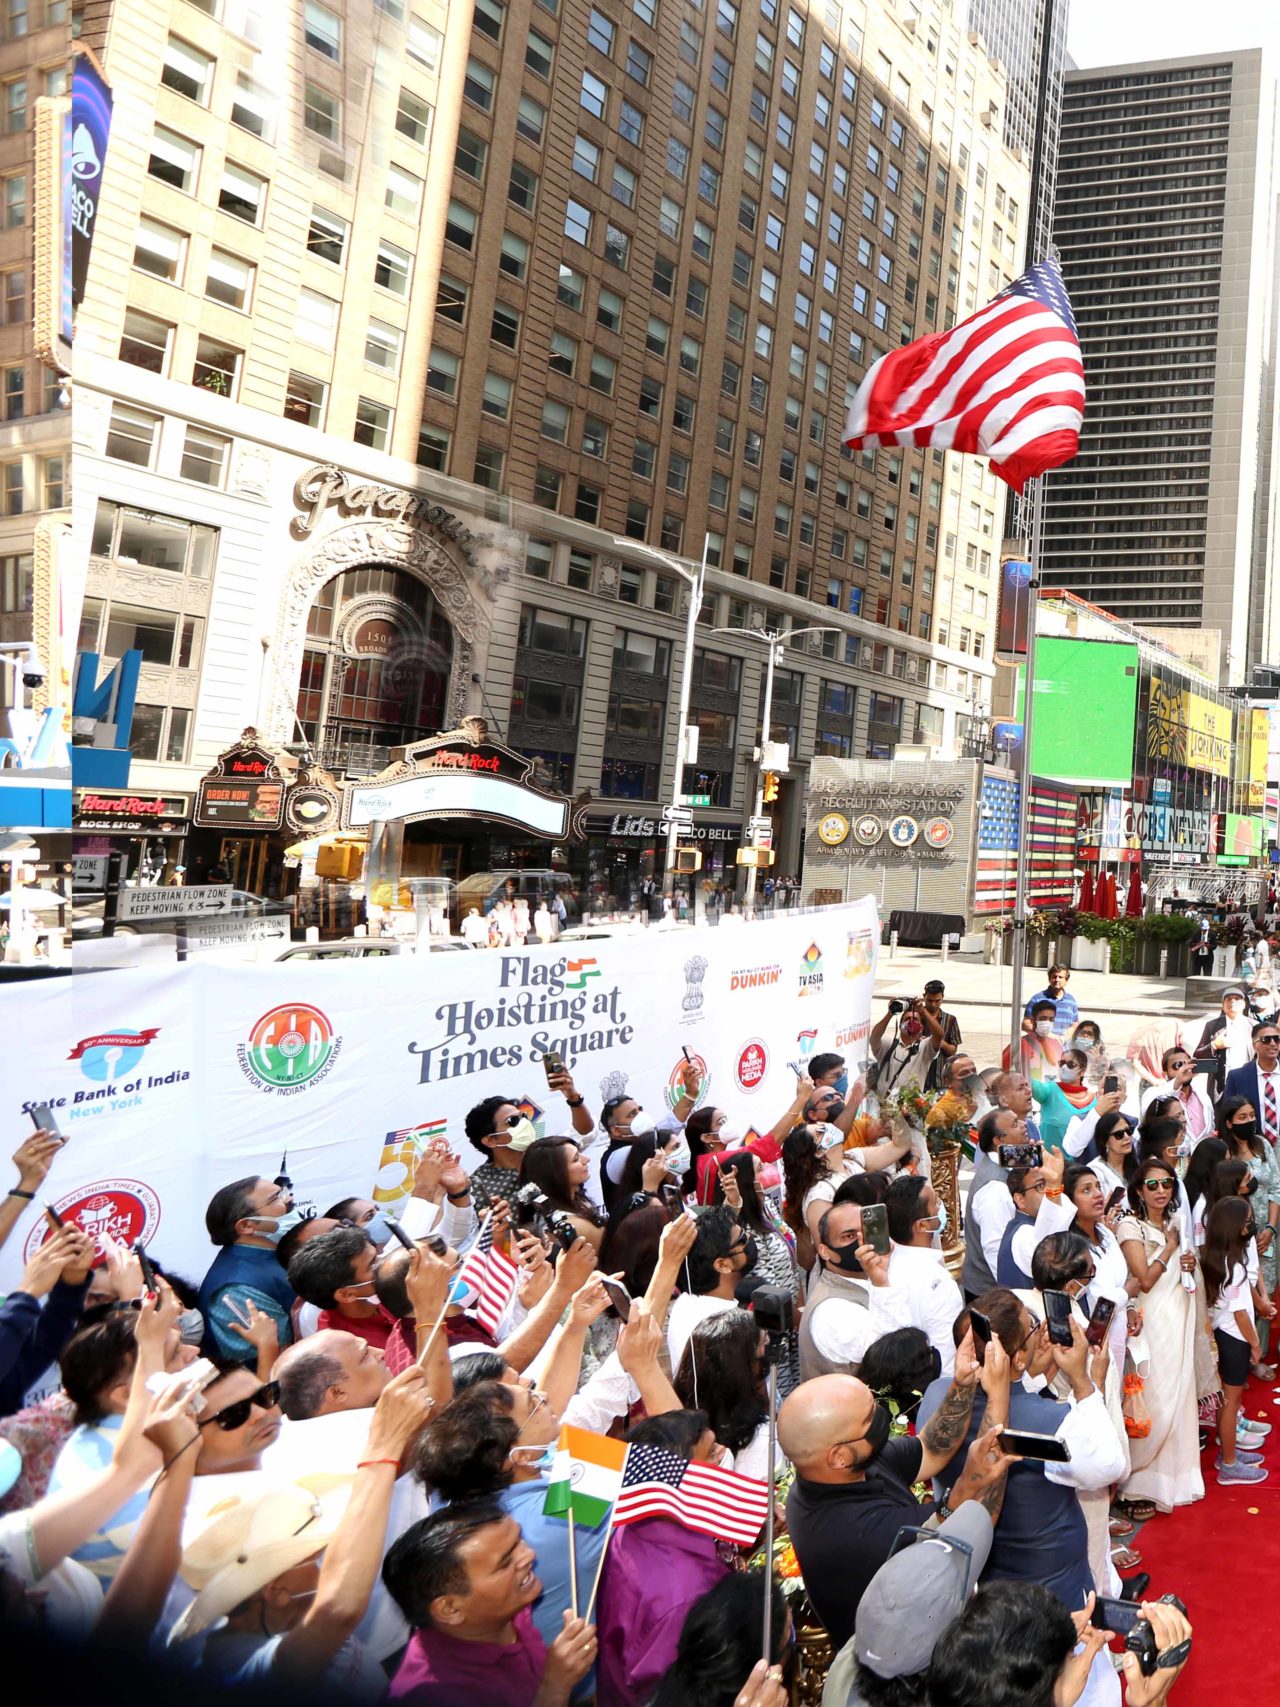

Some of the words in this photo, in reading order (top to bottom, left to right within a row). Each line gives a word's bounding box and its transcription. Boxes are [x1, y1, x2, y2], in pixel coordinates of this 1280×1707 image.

[1204, 713, 1216, 729] THE
[1253, 732, 1268, 740] PRIDE
[1191, 727, 1209, 758] LION
[1209, 735, 1228, 763] KING
[232, 761, 254, 772] Hard
[435, 750, 469, 766] Hard
[469, 753, 500, 773] Rock
[206, 789, 231, 800] ORDER
[231, 790, 250, 800] NOW!
[903, 783, 967, 798] FORCES
[82, 795, 127, 811] Hard
[126, 797, 168, 814] Rock
[820, 797, 900, 811] RECRUITING
[902, 800, 958, 813] STATION
[79, 820, 111, 829] ROCK
[112, 821, 142, 829] SHOP
[611, 814, 654, 836] Lids
[1137, 811, 1165, 843] CBS
[1168, 814, 1207, 846] NEWS
[708, 829, 733, 841] BELL
[1144, 852, 1171, 861] SKECHER
[79, 860, 98, 870] ZONE
[131, 891, 181, 902] PEDESTRIAN
[183, 890, 205, 899] FLOW
[207, 889, 228, 899] ZONE
[130, 905, 150, 915] KEEP
[153, 903, 184, 914] MOVING
[200, 923, 243, 935] PEDESTRIAN
[267, 920, 286, 929] ZONE
[219, 935, 247, 945] MOVING
[498, 956, 567, 997] Flag
[731, 969, 782, 991] DUNKIN'
[799, 976, 808, 987] TV
[808, 973, 824, 986] ASIA
[435, 991, 587, 1037] Hoisting
[592, 986, 627, 1025] at
[97, 1037, 146, 1045] ANNIVERSARY
[260, 1014, 323, 1076] FIA
[408, 1034, 523, 1085] Times
[529, 1025, 634, 1071] Square
[236, 1043, 263, 1089] FEDERATION
[263, 1084, 276, 1094] OF
[277, 1084, 306, 1096] INDIAN
[309, 1035, 343, 1088] ASSOCIATIONS
[742, 1070, 762, 1081] MEDIA
[21, 1096, 67, 1115] State
[74, 1084, 117, 1103] Bank
[124, 1078, 142, 1093] of
[148, 1069, 190, 1088] India
[70, 1103, 104, 1119] New
[110, 1095, 142, 1111] York
[56, 1192, 82, 1211] NEWS
[85, 1183, 110, 1194] INDIA
[113, 1182, 135, 1191] TIMES
[142, 1193, 156, 1221] GUJARAT
[84, 1212, 132, 1234] RIKH
